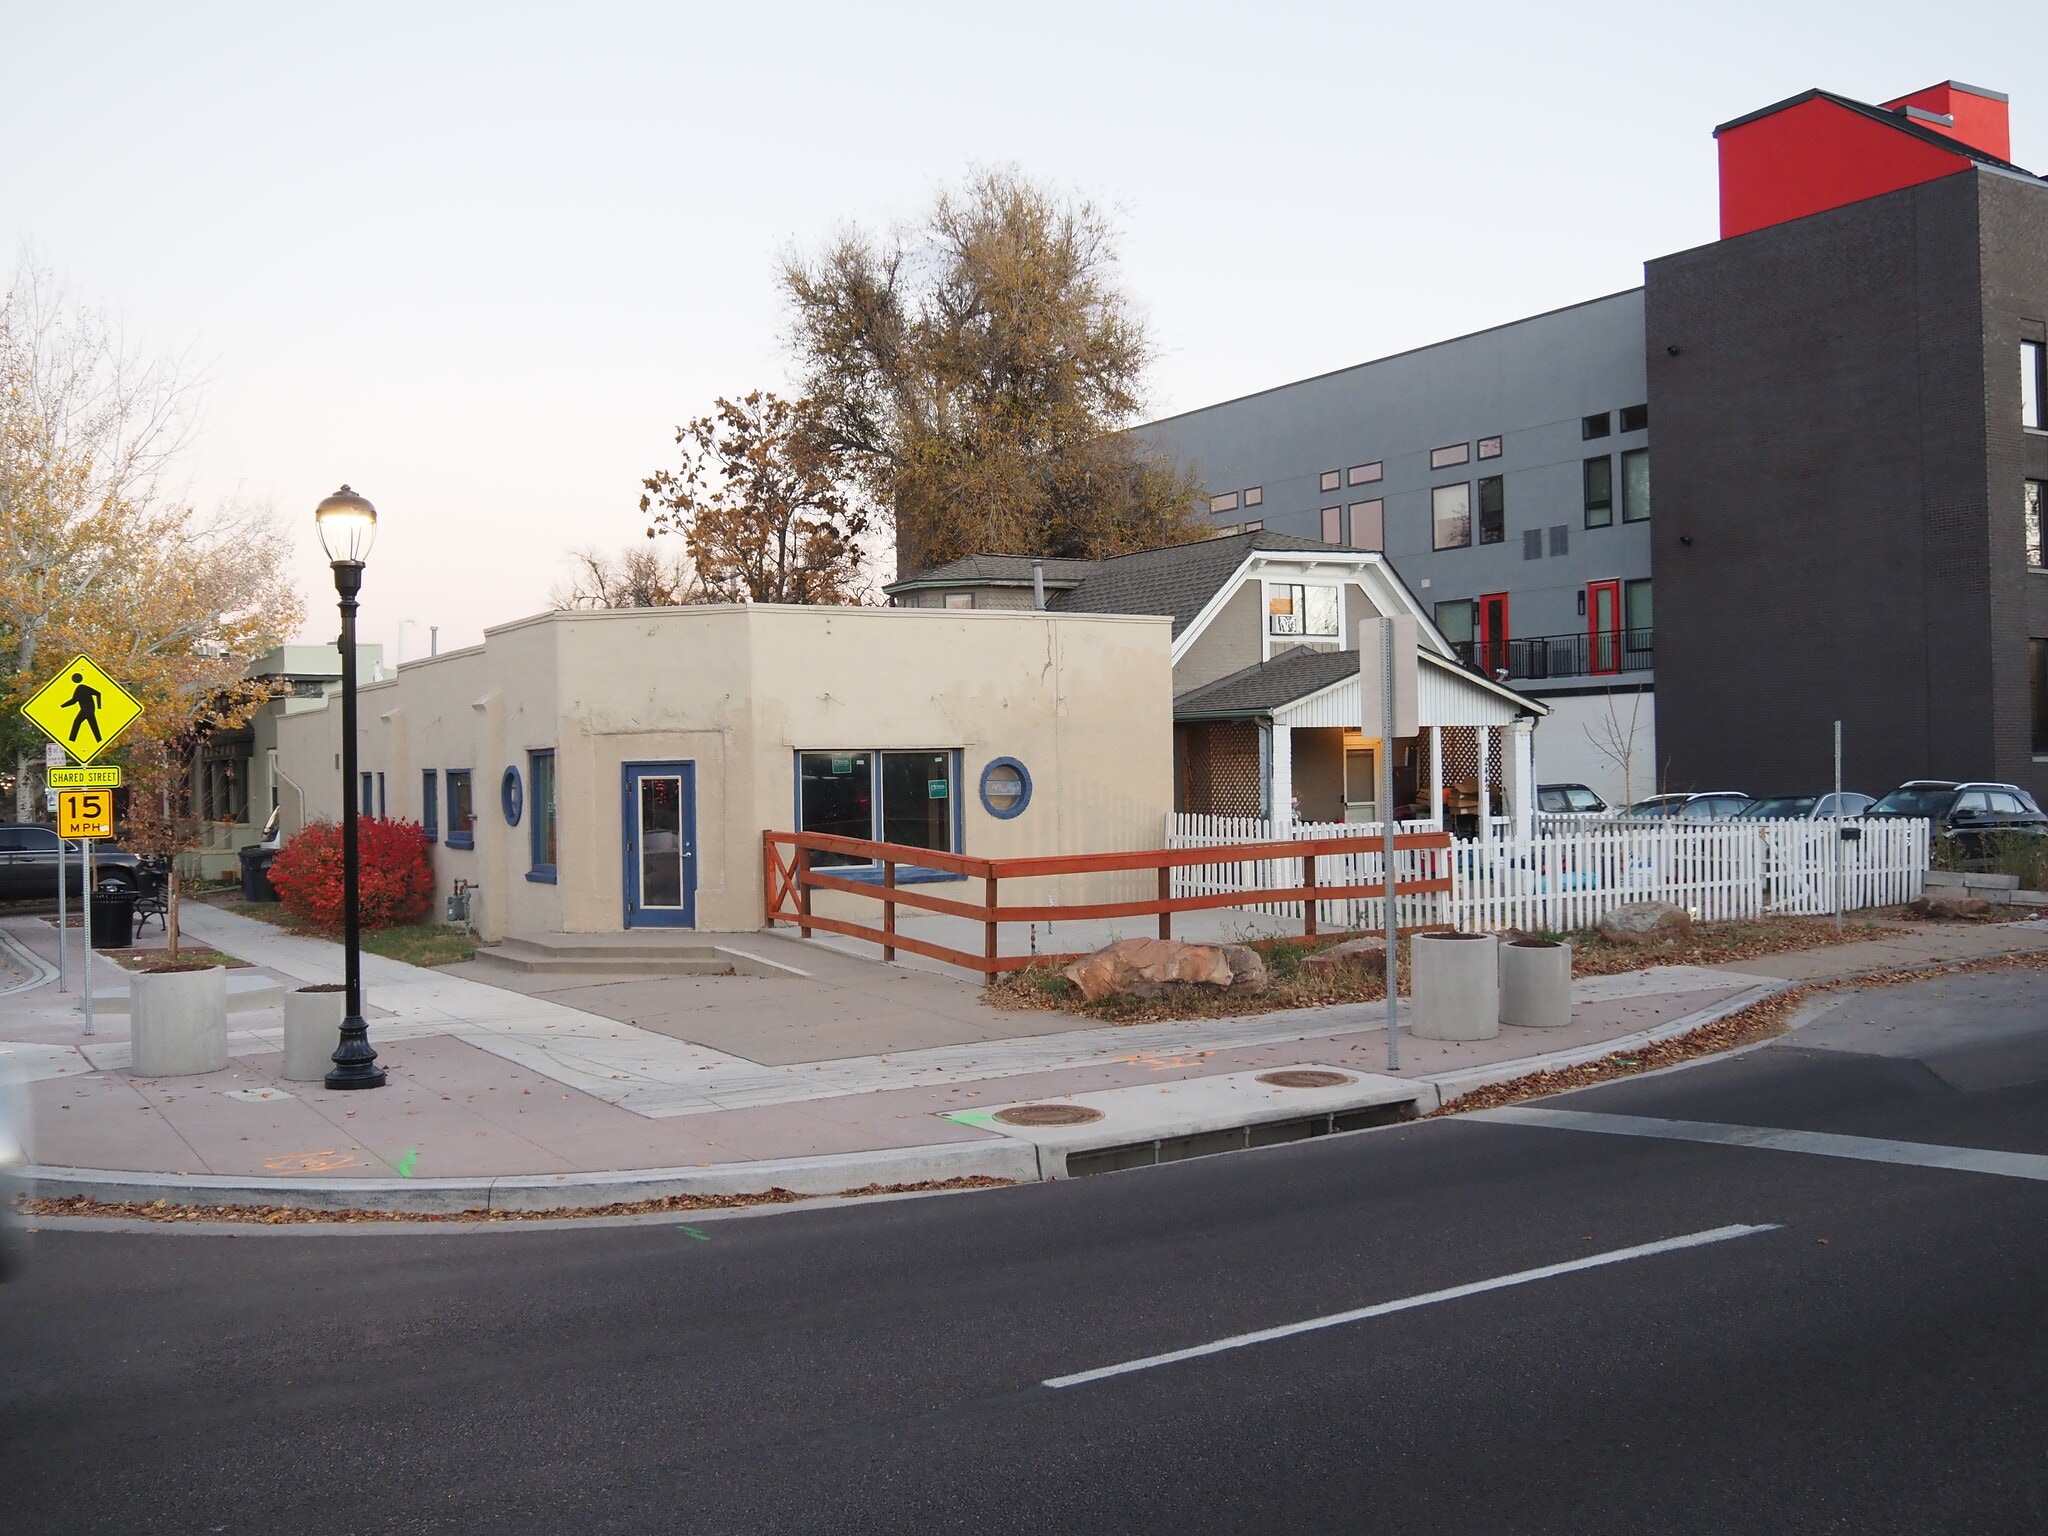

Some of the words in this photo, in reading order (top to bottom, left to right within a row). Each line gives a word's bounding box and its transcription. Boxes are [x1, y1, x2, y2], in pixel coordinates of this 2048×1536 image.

[52, 773, 84, 783] SHARED
[88, 772, 116, 782] STREET
[68, 796, 102, 819] 15
[70, 823, 100, 833] MPH
